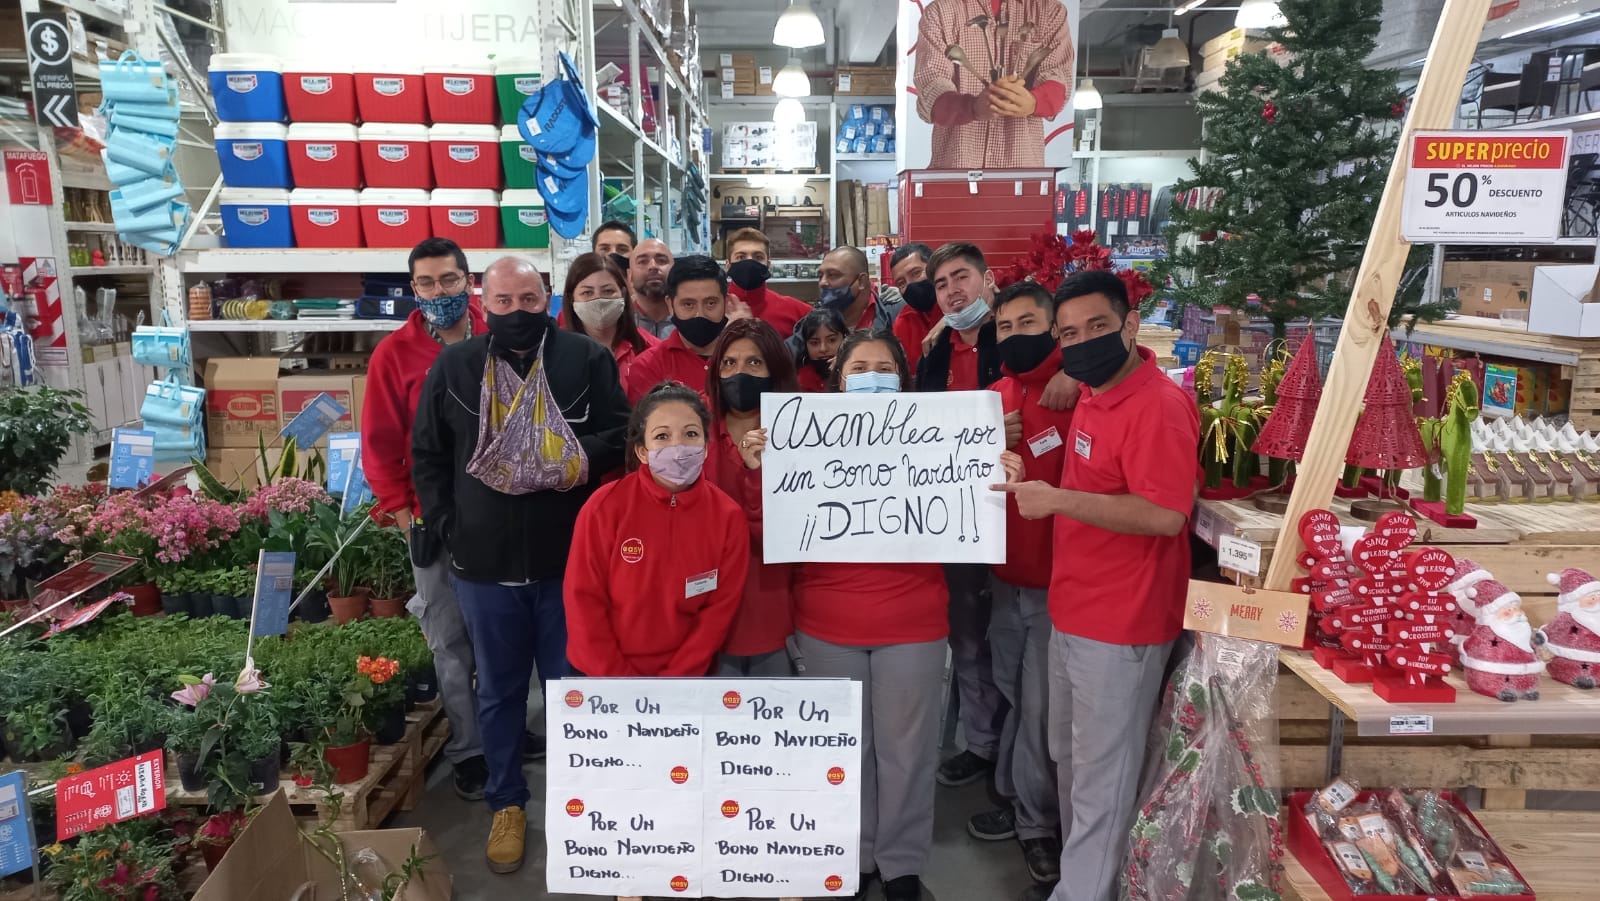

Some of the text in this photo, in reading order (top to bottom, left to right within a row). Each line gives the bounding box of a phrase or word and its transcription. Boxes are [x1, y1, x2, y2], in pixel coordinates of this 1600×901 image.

[46, 82, 73, 90] PRECIO
[6, 151, 47, 161] MATAFUEGO
[1489, 189, 1543, 198] DESCUENTO
[1480, 210, 1517, 218] NAVIDEÑOS
[954, 424, 997, 462] por
[772, 467, 816, 494] un
[1310, 513, 1331, 523] SANTA
[1388, 516, 1410, 526] SANTA
[1313, 523, 1331, 533] SANTA
[1365, 537, 1389, 548] SANTA
[622, 546, 642, 554] easy
[1227, 547, 1248, 561] 1.395
[1422, 552, 1448, 563] SANTA
[1363, 561, 1377, 572] STOP
[1417, 575, 1450, 588] STOP HERE
[1230, 604, 1264, 621] MERRY
[1361, 613, 1392, 623] CROSSING
[1408, 631, 1441, 640] CROSSING
[153, 758, 162, 790] EXTERIOR
